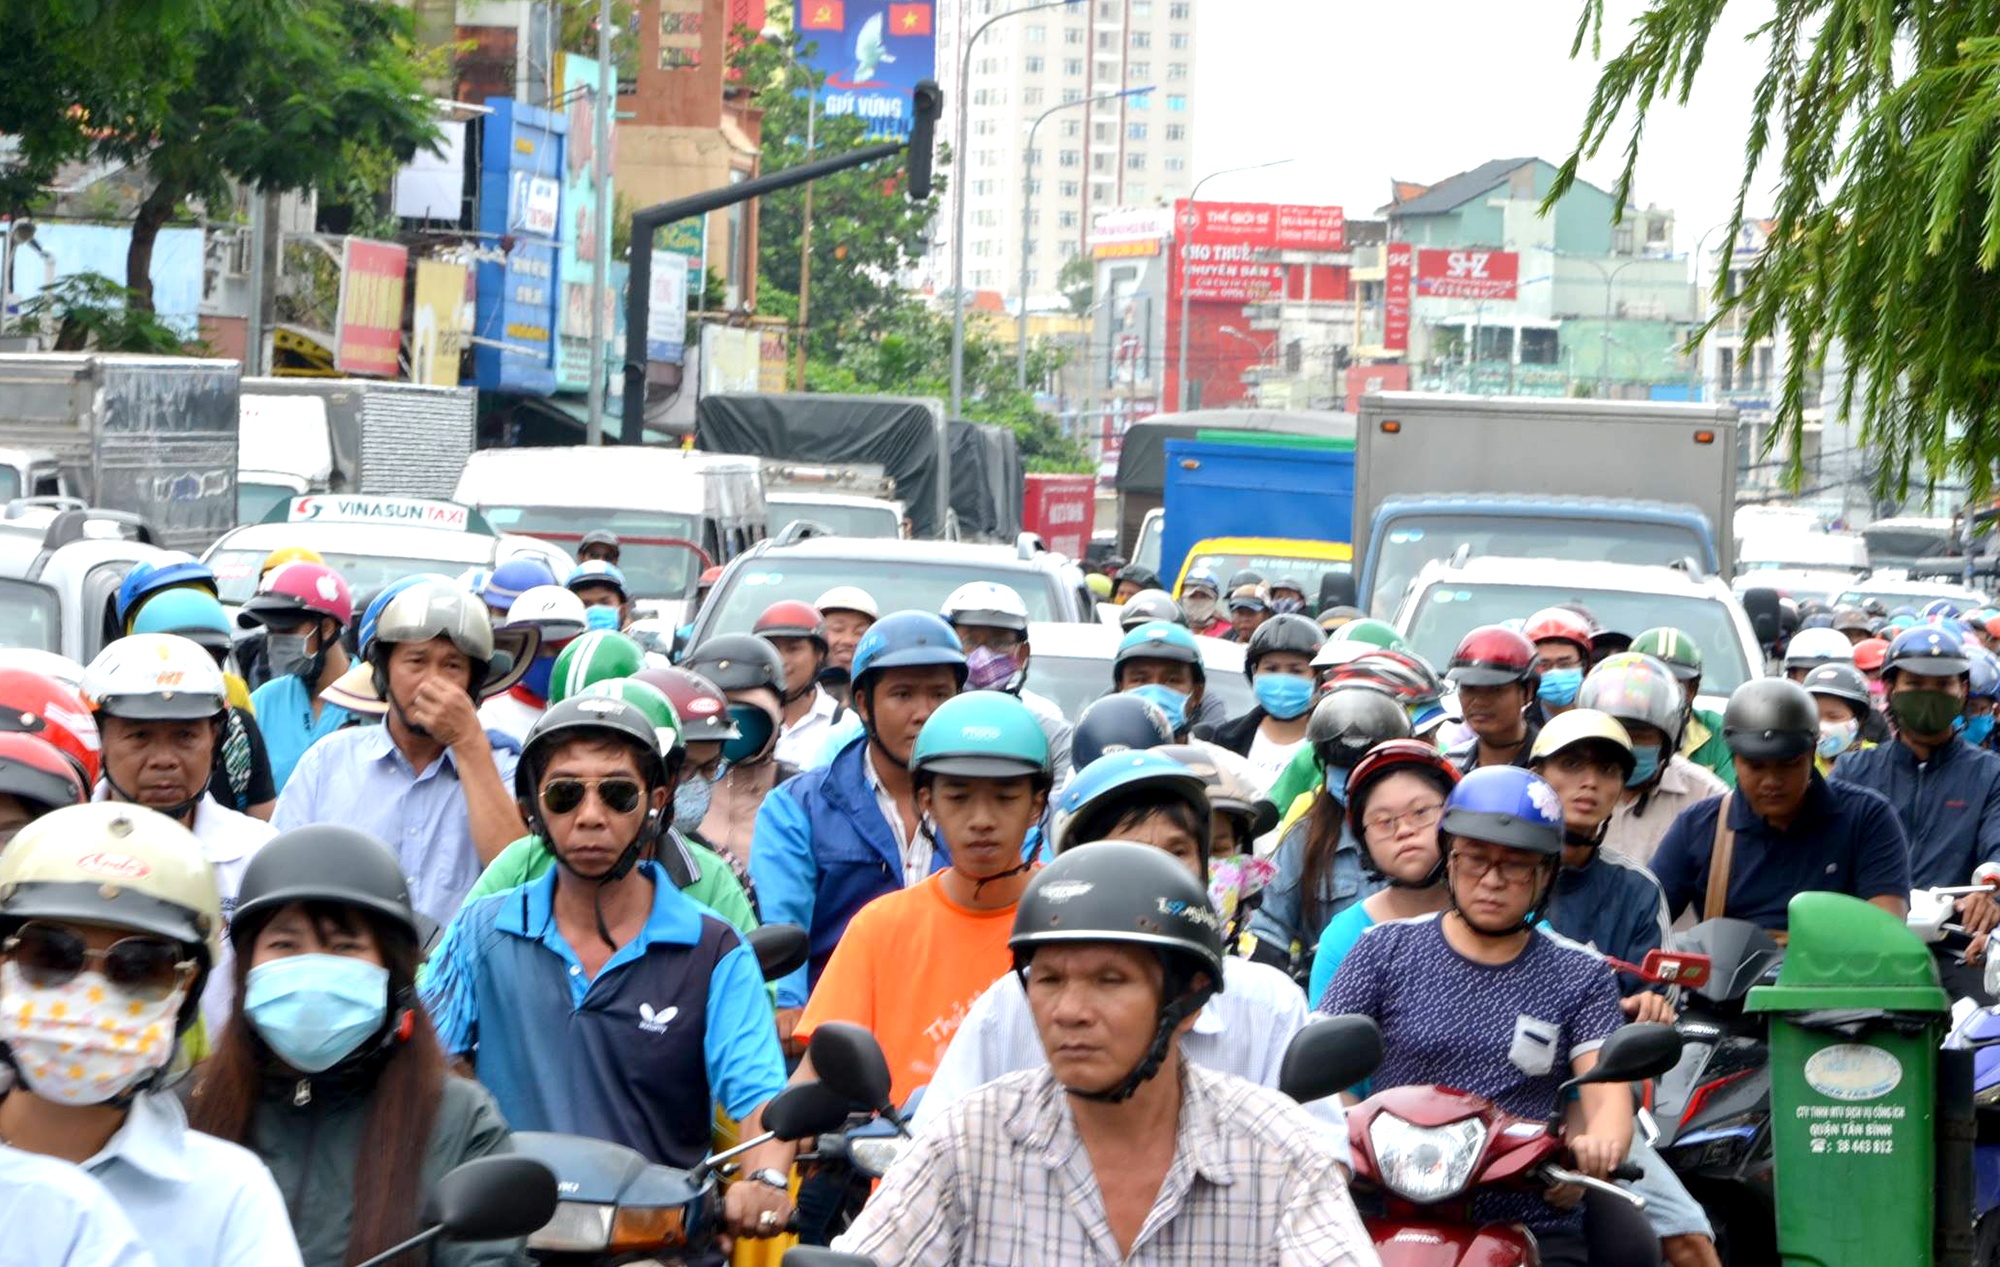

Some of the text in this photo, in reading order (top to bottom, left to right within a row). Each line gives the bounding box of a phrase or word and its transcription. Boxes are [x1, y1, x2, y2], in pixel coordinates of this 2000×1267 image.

[338, 501, 464, 524] VINASUN TAXI
[1841, 1121, 1864, 1136] TÂN
